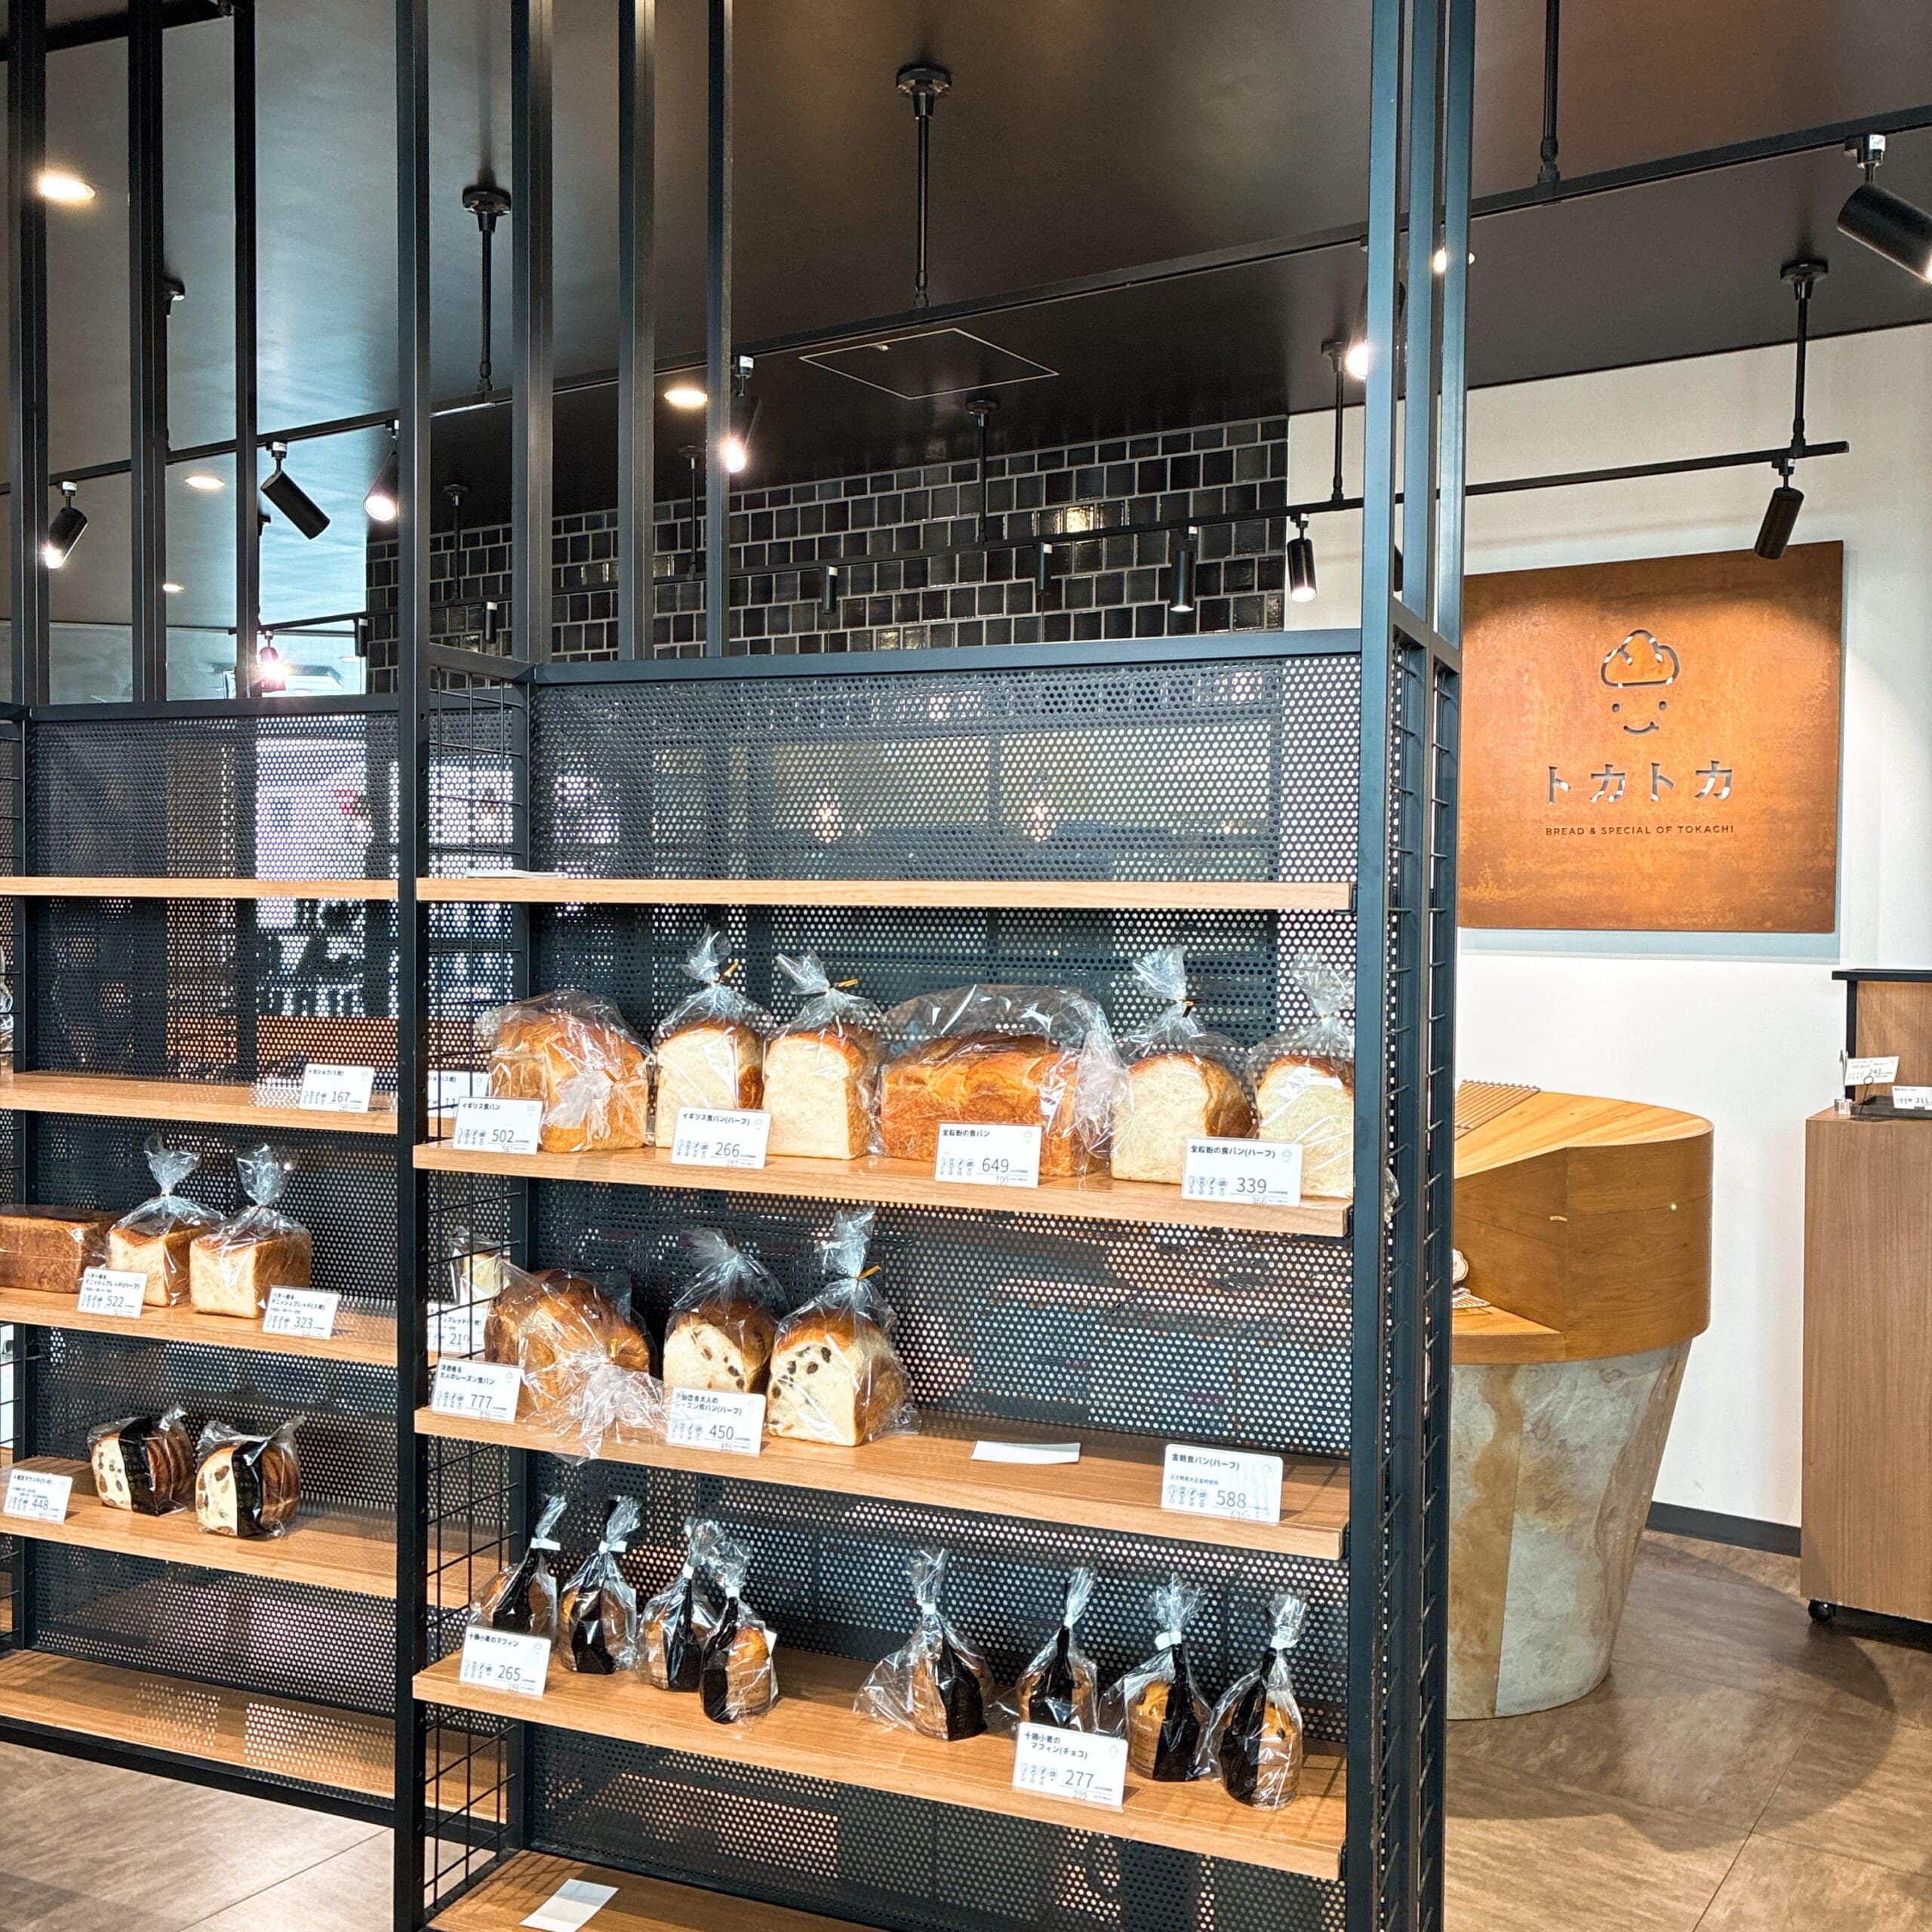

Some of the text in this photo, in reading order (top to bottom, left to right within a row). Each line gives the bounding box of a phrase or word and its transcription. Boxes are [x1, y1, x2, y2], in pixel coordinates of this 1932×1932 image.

[1548, 760, 1733, 804] トカトカ
[1546, 825, 1734, 836] BREAD & SPECIAL OF TOKACHI
[331, 1091, 351, 1103] 167
[491, 1129, 515, 1143] 502
[715, 1142, 740, 1158] 266
[982, 1158, 1009, 1173] 649
[1236, 1177, 1267, 1194] 339
[106, 1295, 125, 1307] 522
[294, 1316, 313, 1329] 323
[471, 1393, 493, 1409] 777
[709, 1424, 734, 1440] 450
[32, 1499, 49, 1511] 448
[1216, 1490, 1247, 1509] 588
[498, 1664, 521, 1681] 265
[1065, 1769, 1094, 1789] 277
